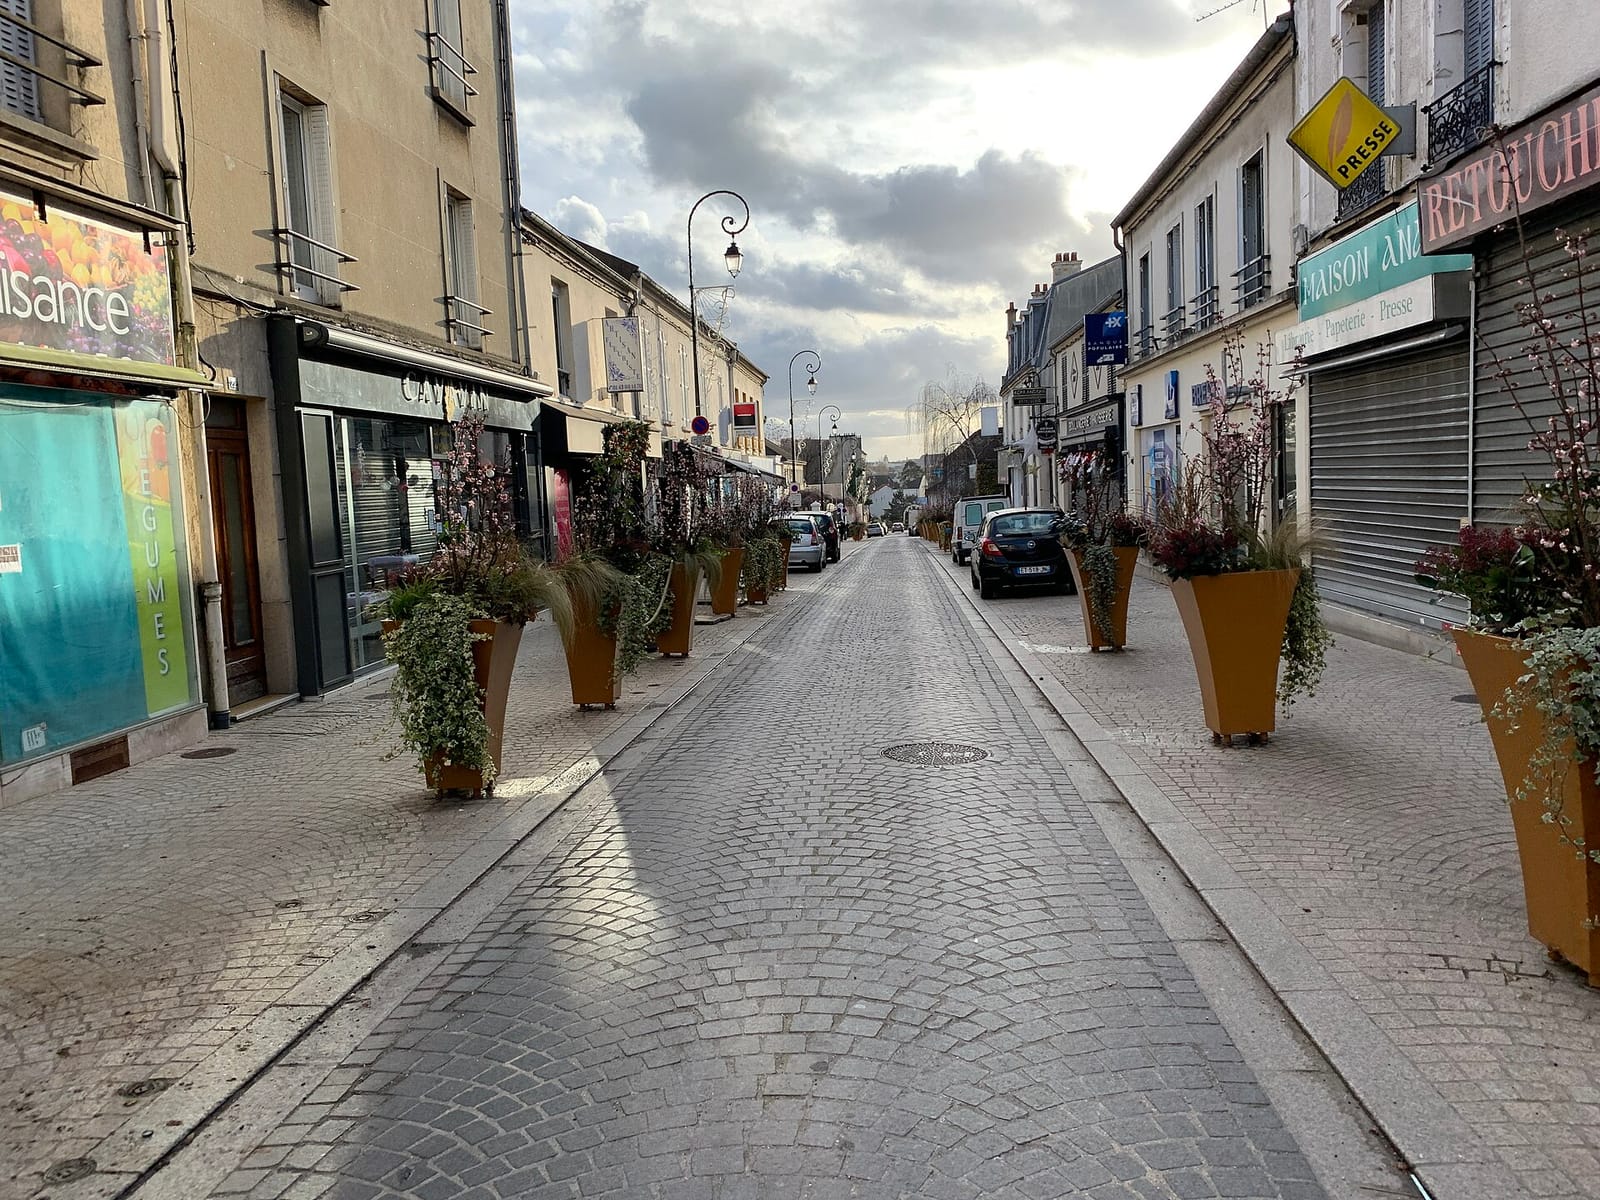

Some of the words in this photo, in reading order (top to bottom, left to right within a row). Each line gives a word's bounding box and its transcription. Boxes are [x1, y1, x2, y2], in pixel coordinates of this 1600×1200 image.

[1337, 121, 1393, 179] PRESSE
[0, 252, 130, 335] isance
[1303, 246, 1369, 306] MAISON
[1325, 309, 1366, 342] Papeterie
[1380, 297, 1413, 321] Presse
